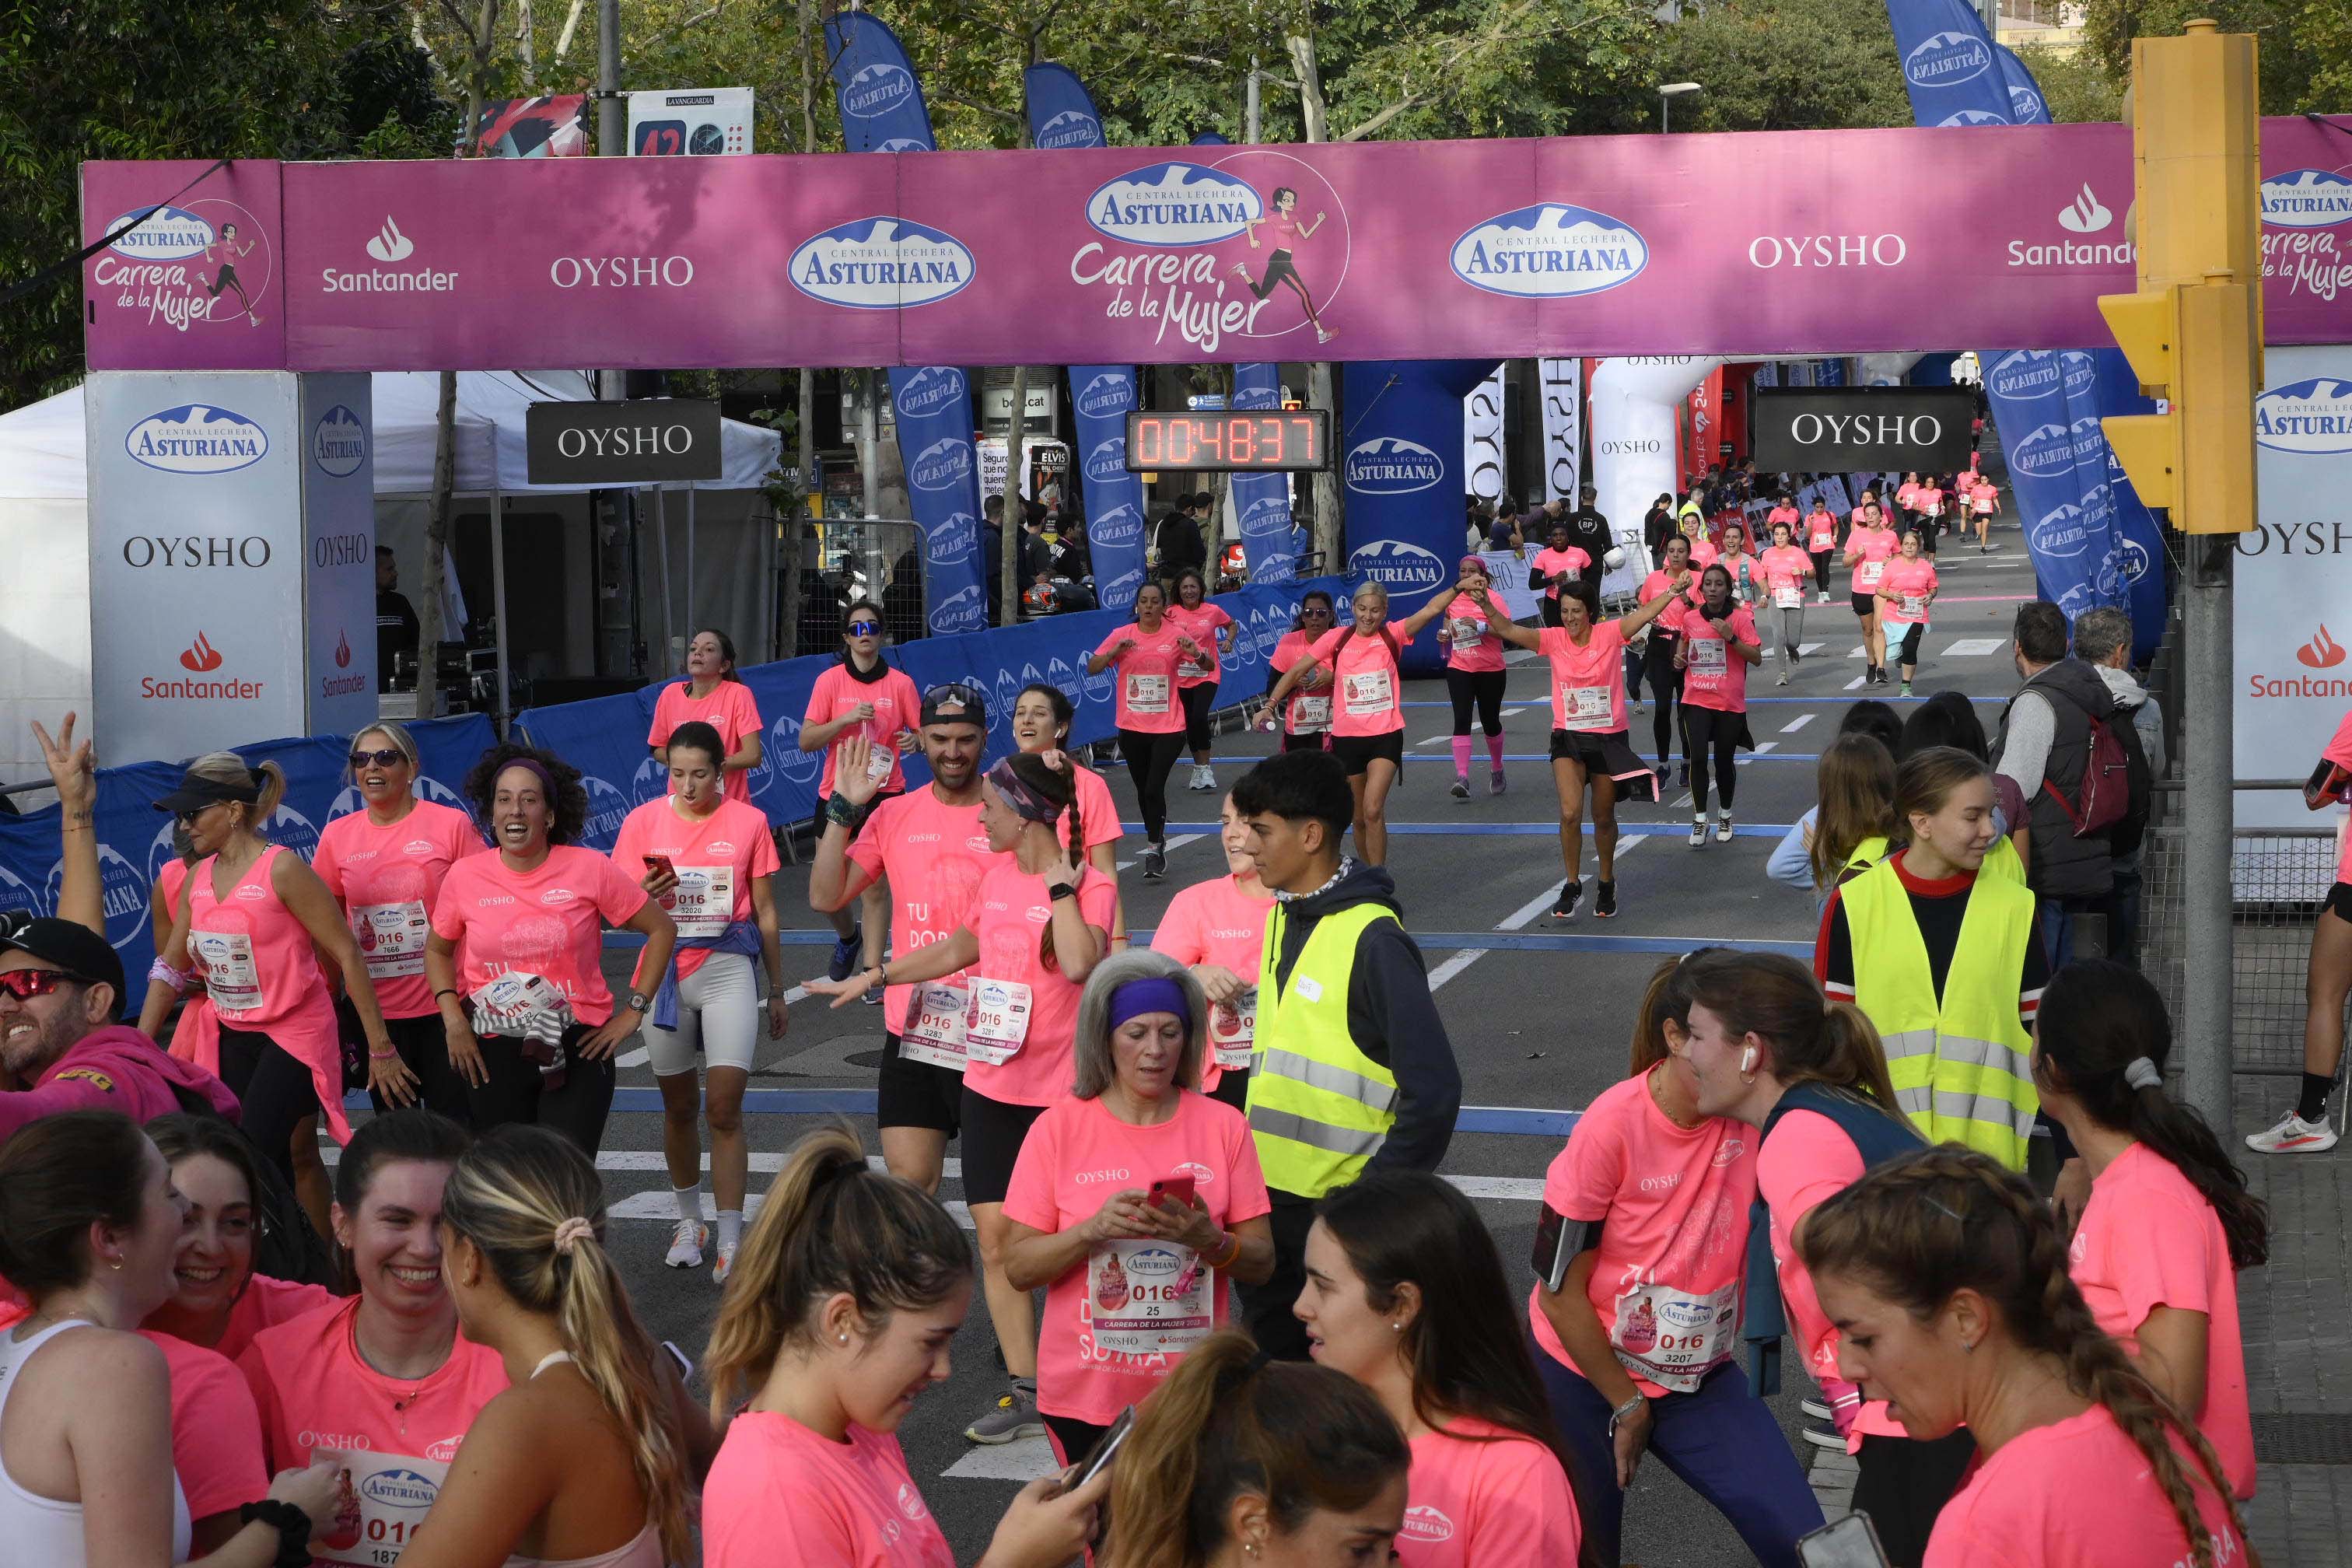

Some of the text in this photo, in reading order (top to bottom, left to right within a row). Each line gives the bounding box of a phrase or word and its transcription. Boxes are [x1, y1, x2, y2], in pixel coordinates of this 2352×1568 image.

[676, 96, 714, 106] VANGUARDIA
[1125, 190, 1244, 201] CENTRAL LECHERA
[1099, 194, 1249, 226] ASTURIANA
[167, 222, 204, 231] LECHERA
[112, 226, 207, 247] ASTURIANA
[1496, 234, 1626, 247] CENTRAL LECHERA
[2259, 232, 2336, 255] arrera
[831, 247, 955, 258] CENTRAL LECHERA
[1465, 240, 1634, 275] ASTURIANA
[1748, 234, 1906, 269] OYSHO
[94, 256, 187, 287] Carrera
[550, 255, 695, 288] OYSHO
[802, 250, 961, 285] ASTURIANA
[1070, 241, 1219, 286] Carrera
[2279, 255, 2293, 277] la
[322, 268, 459, 292] Santander
[117, 282, 221, 331] de la Mujer
[1106, 279, 1271, 353] de la Mujer
[2277, 405, 2329, 414] CENTRAL
[1790, 413, 1941, 446] OYSHO
[136, 429, 259, 457] ASTURIANA
[317, 436, 363, 460] ASTURIANA
[557, 425, 693, 458] OYSHO
[1138, 418, 1314, 463] 00:48:37
[1601, 439, 1661, 456] OYSHO
[1041, 453, 1066, 464] ELVIS
[983, 467, 996, 476] que
[1348, 460, 1437, 482] ASTURIANA
[984, 476, 1006, 485] quiere
[122, 536, 271, 568] OYSHO
[315, 533, 368, 568] OYSHO
[1349, 562, 1437, 583] TURIANA
[141, 677, 264, 700] Santander
[321, 674, 366, 698] Santander
[778, 749, 818, 769] ASTURIANA
[908, 833, 941, 843] OYSHO
[346, 850, 378, 863] OYSHO
[404, 843, 432, 854] ASTURIANA
[478, 896, 515, 907] OYSHO
[542, 893, 573, 904] ASTURIANA
[678, 894, 705, 905] 016
[907, 901, 929, 922] TU
[377, 932, 404, 944] 016
[1211, 929, 1251, 939] OYSHO
[493, 985, 519, 1002] ASTURIANA
[926, 995, 957, 1009] ASTURIANA
[982, 992, 1006, 1003] ASTURIANA
[506, 999, 532, 1018] 016
[922, 1013, 952, 1030] 016
[979, 1012, 1002, 1026] 016
[923, 1028, 943, 1039] 3283
[982, 1027, 995, 1036] 3281
[1076, 1167, 1129, 1185] OYSHO
[1131, 1258, 1178, 1270] ASTURIANA
[1132, 1285, 1176, 1301] 016
[1146, 1306, 1160, 1317] 25
[1664, 1306, 1711, 1324] ASTURIANA
[1103, 1335, 1139, 1346] OYSHO
[1660, 1333, 1705, 1351] 016
[1664, 1353, 1693, 1363] 3207
[1619, 1357, 1659, 1379] OYSHO
[1661, 1364, 1673, 1373] DE
[298, 1430, 371, 1451] OYSHO
[367, 1479, 436, 1502] ASTURIANA
